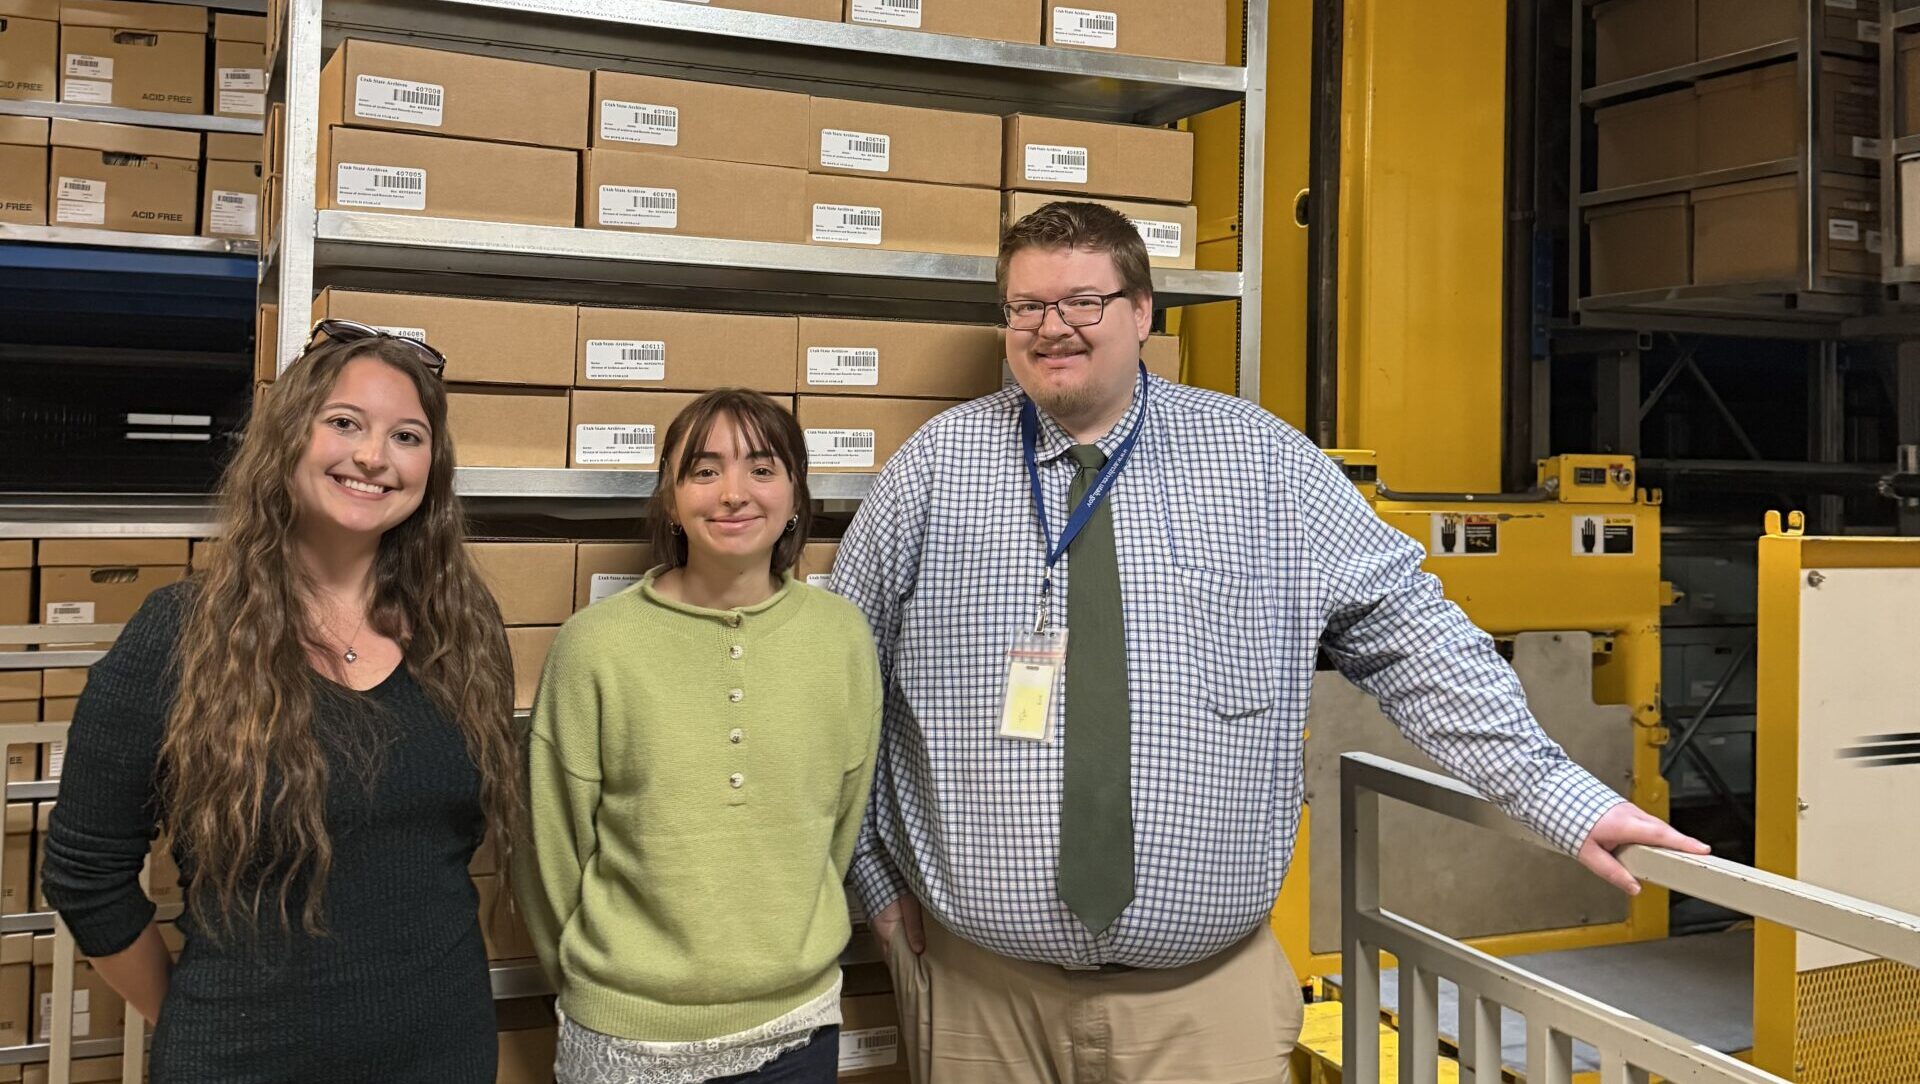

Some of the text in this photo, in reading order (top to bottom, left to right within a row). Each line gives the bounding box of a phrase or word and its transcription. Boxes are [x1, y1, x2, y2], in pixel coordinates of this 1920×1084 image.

[0, 80, 15, 89] CID
[142, 93, 193, 104] ACID FREE
[5, 202, 33, 211] FREE
[131, 210, 184, 222] ACID FREE
[9, 756, 24, 765] EE
